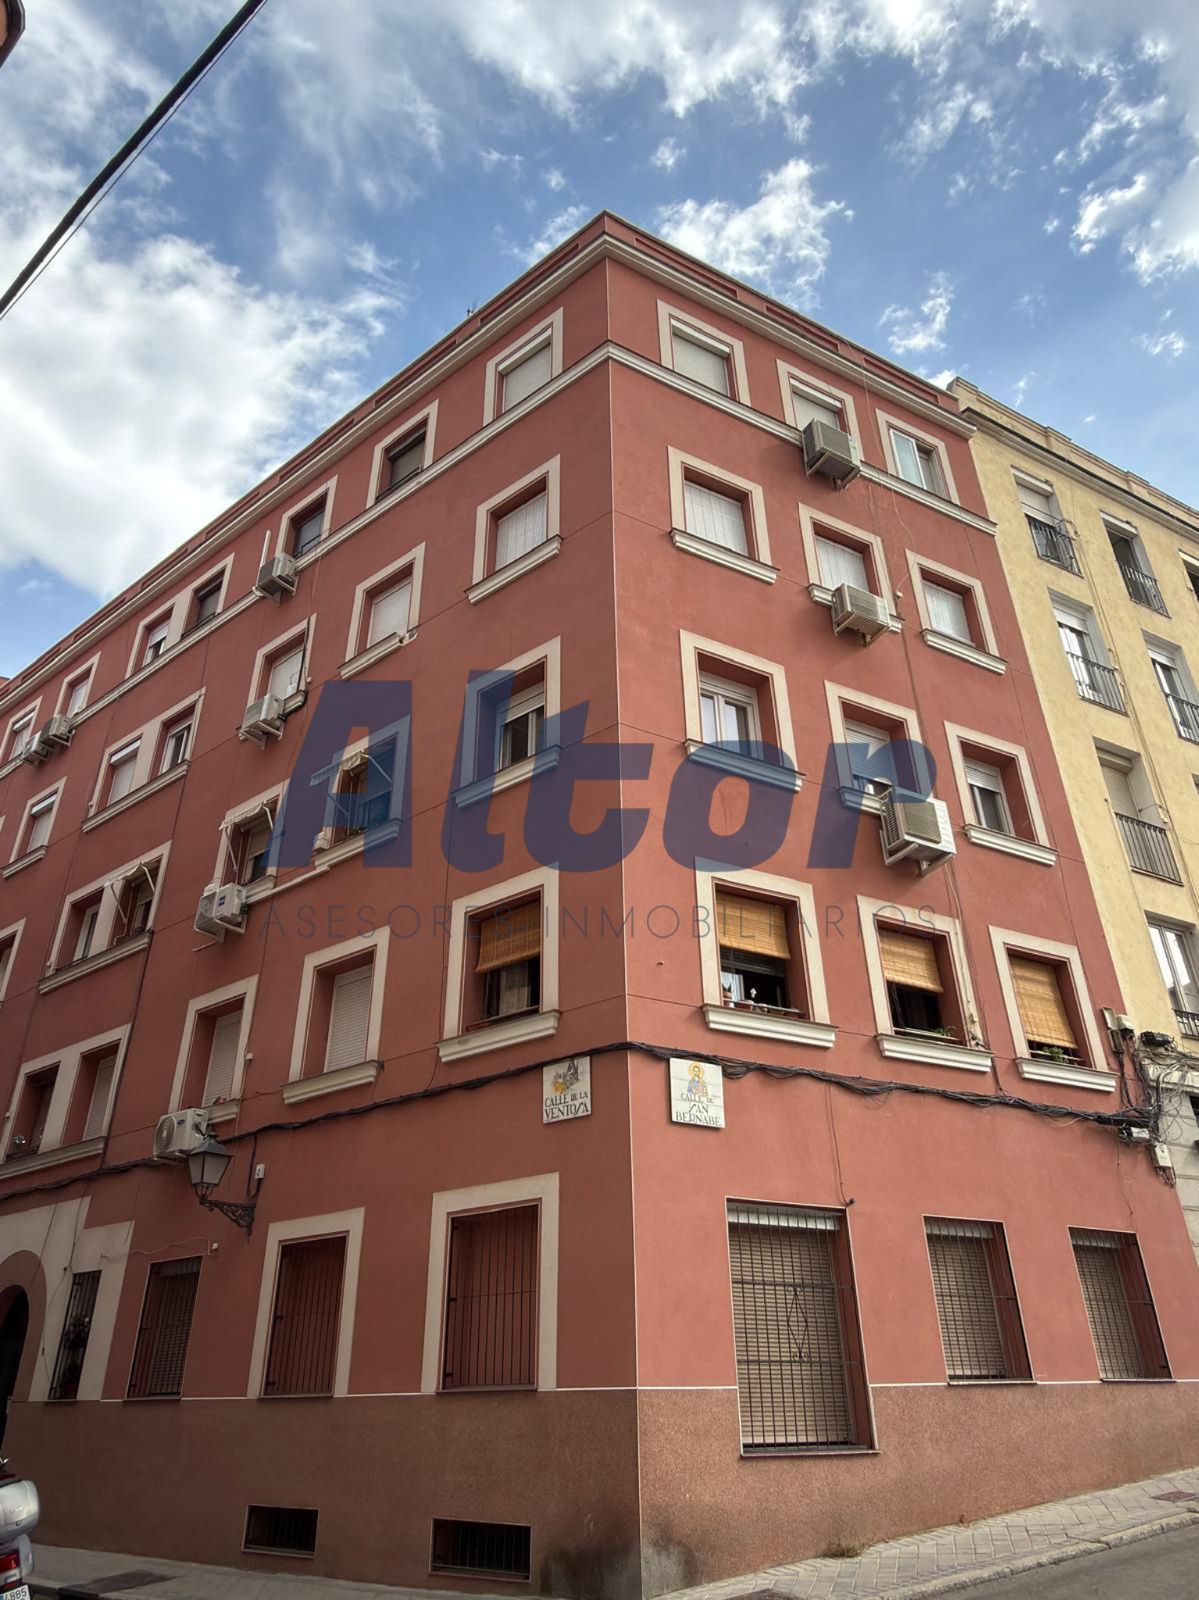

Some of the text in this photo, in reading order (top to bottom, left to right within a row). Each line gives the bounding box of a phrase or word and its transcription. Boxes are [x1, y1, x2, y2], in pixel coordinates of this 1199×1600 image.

[544, 1091, 588, 1107] CALLE DE LA
[681, 1092, 703, 1103] CALLE
[545, 1102, 589, 1119] VENTOSA
[689, 1103, 708, 1114] SAN
